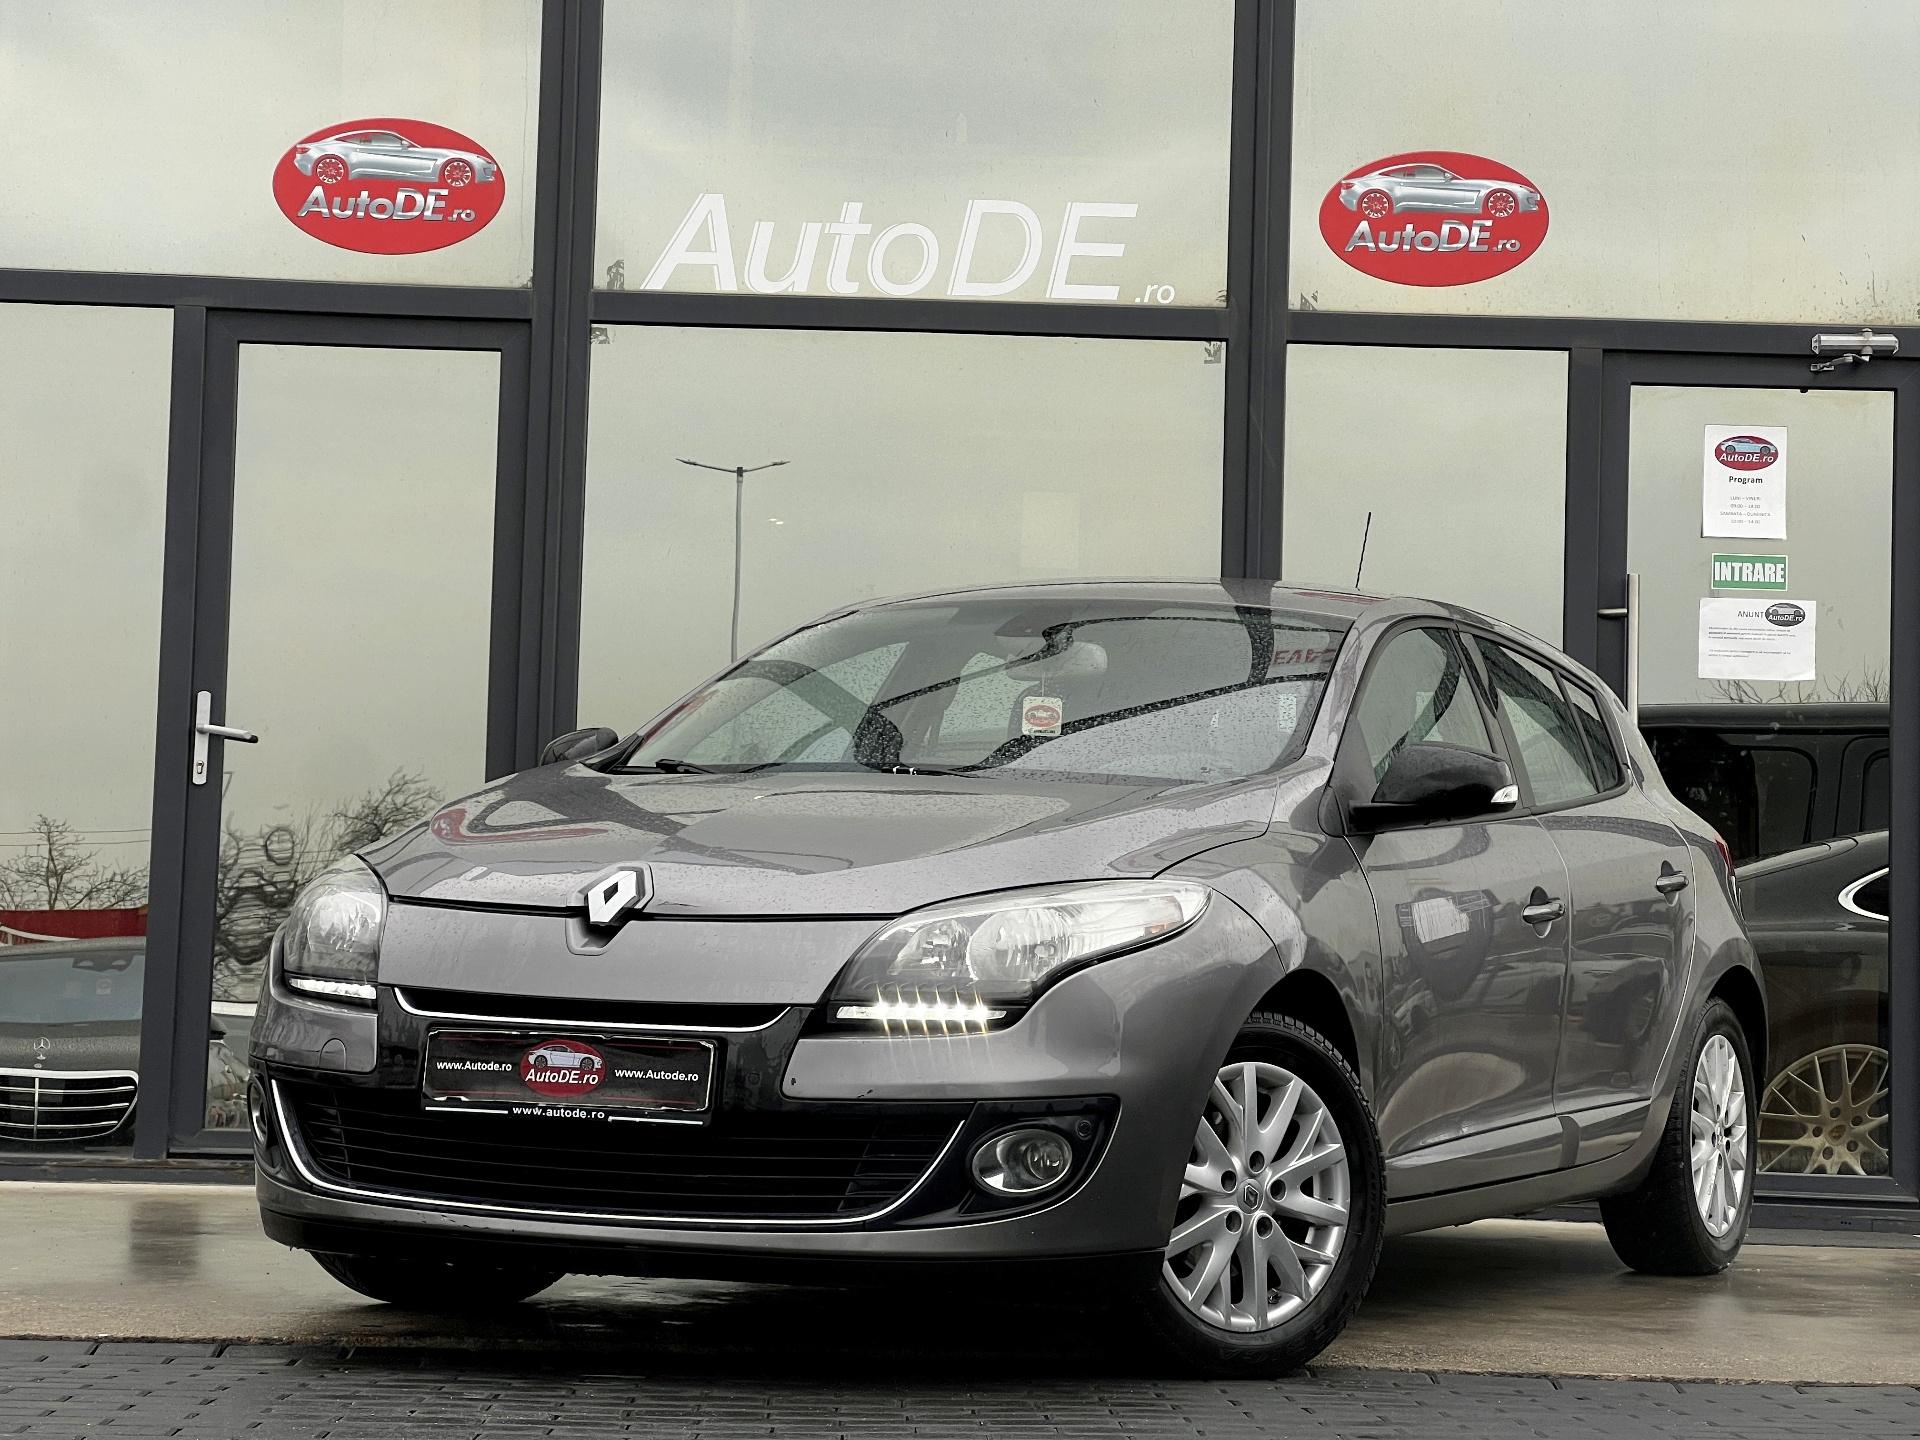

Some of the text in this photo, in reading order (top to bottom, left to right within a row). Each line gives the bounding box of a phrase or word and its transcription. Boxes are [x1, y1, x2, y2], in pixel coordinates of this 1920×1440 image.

[1719, 453, 1774, 463] AutoDE.ro
[1728, 475, 1763, 485] Program
[1714, 561, 1785, 583] INTRARE
[436, 1060, 512, 1072] www.Autode.ro
[524, 1068, 599, 1085] AutoDE.ro
[614, 1068, 699, 1082] www.Autode.ro
[512, 1106, 605, 1119] www.autode.ro
